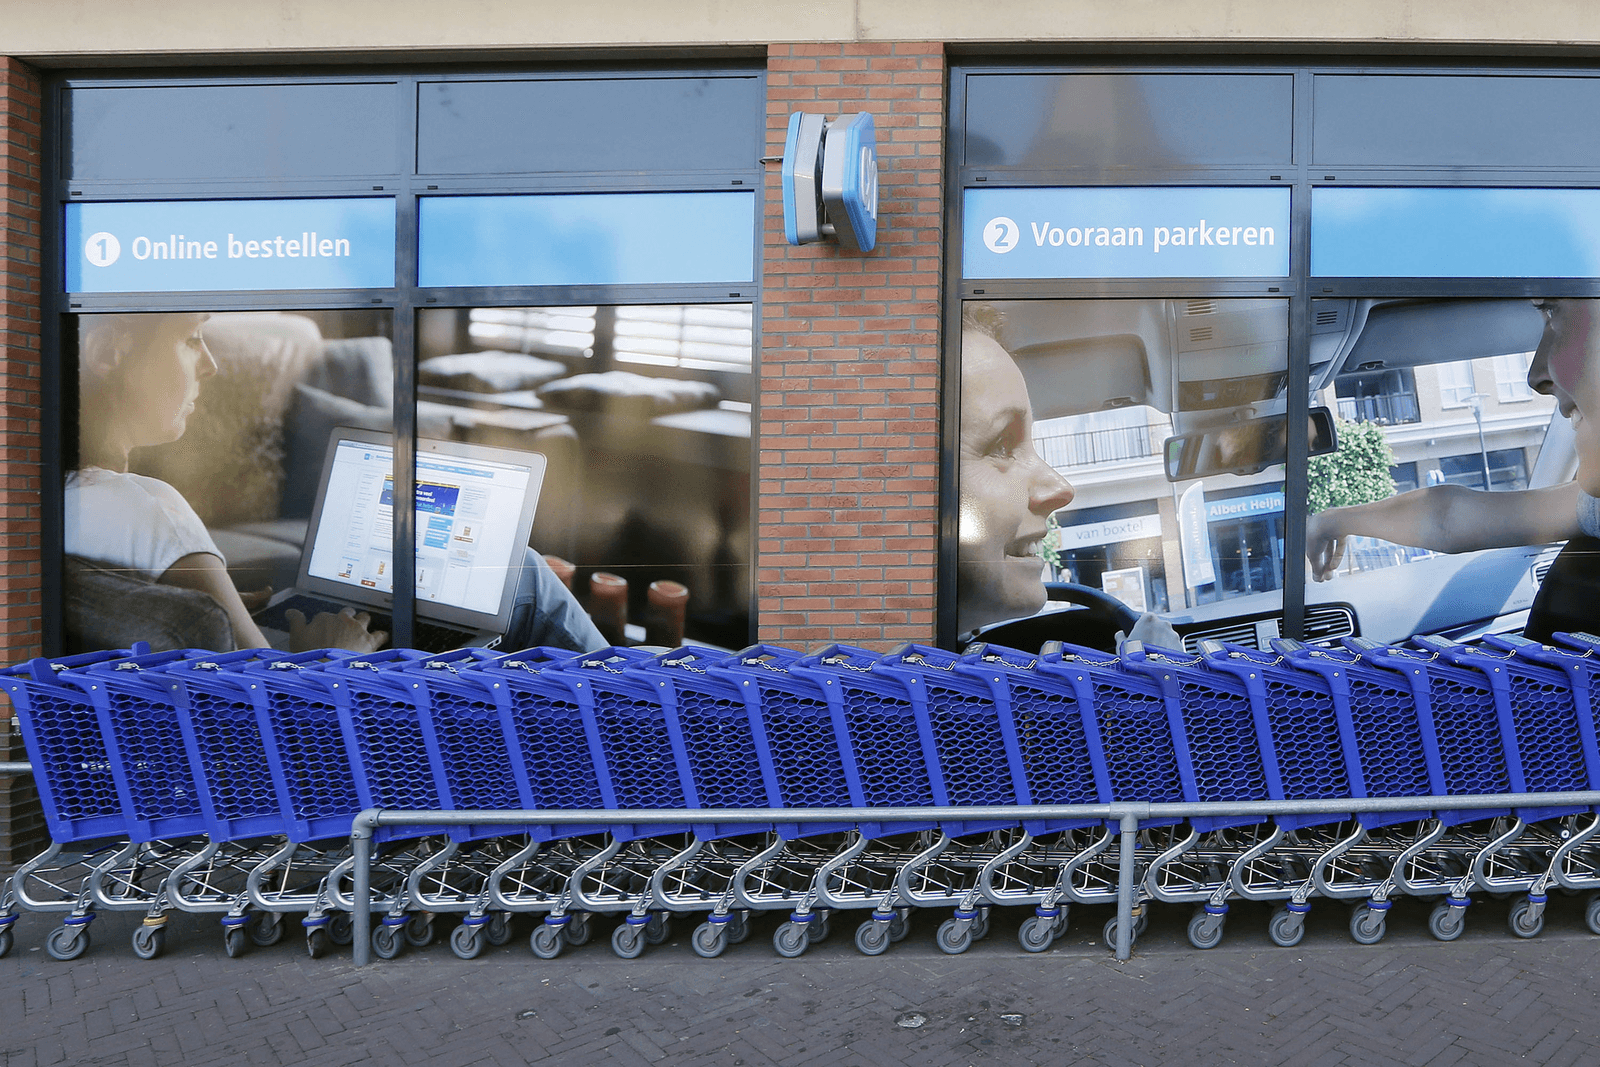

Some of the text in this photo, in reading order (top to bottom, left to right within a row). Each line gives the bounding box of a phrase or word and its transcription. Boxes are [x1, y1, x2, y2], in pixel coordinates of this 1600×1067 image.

[132, 234, 218, 260] Online
[228, 232, 350, 258] bestellen
[1031, 221, 1143, 247] Vooraan
[1154, 219, 1275, 253] parkeren
[1209, 497, 1282, 516] Albert Heijn
[1076, 520, 1144, 540] van boxtel
